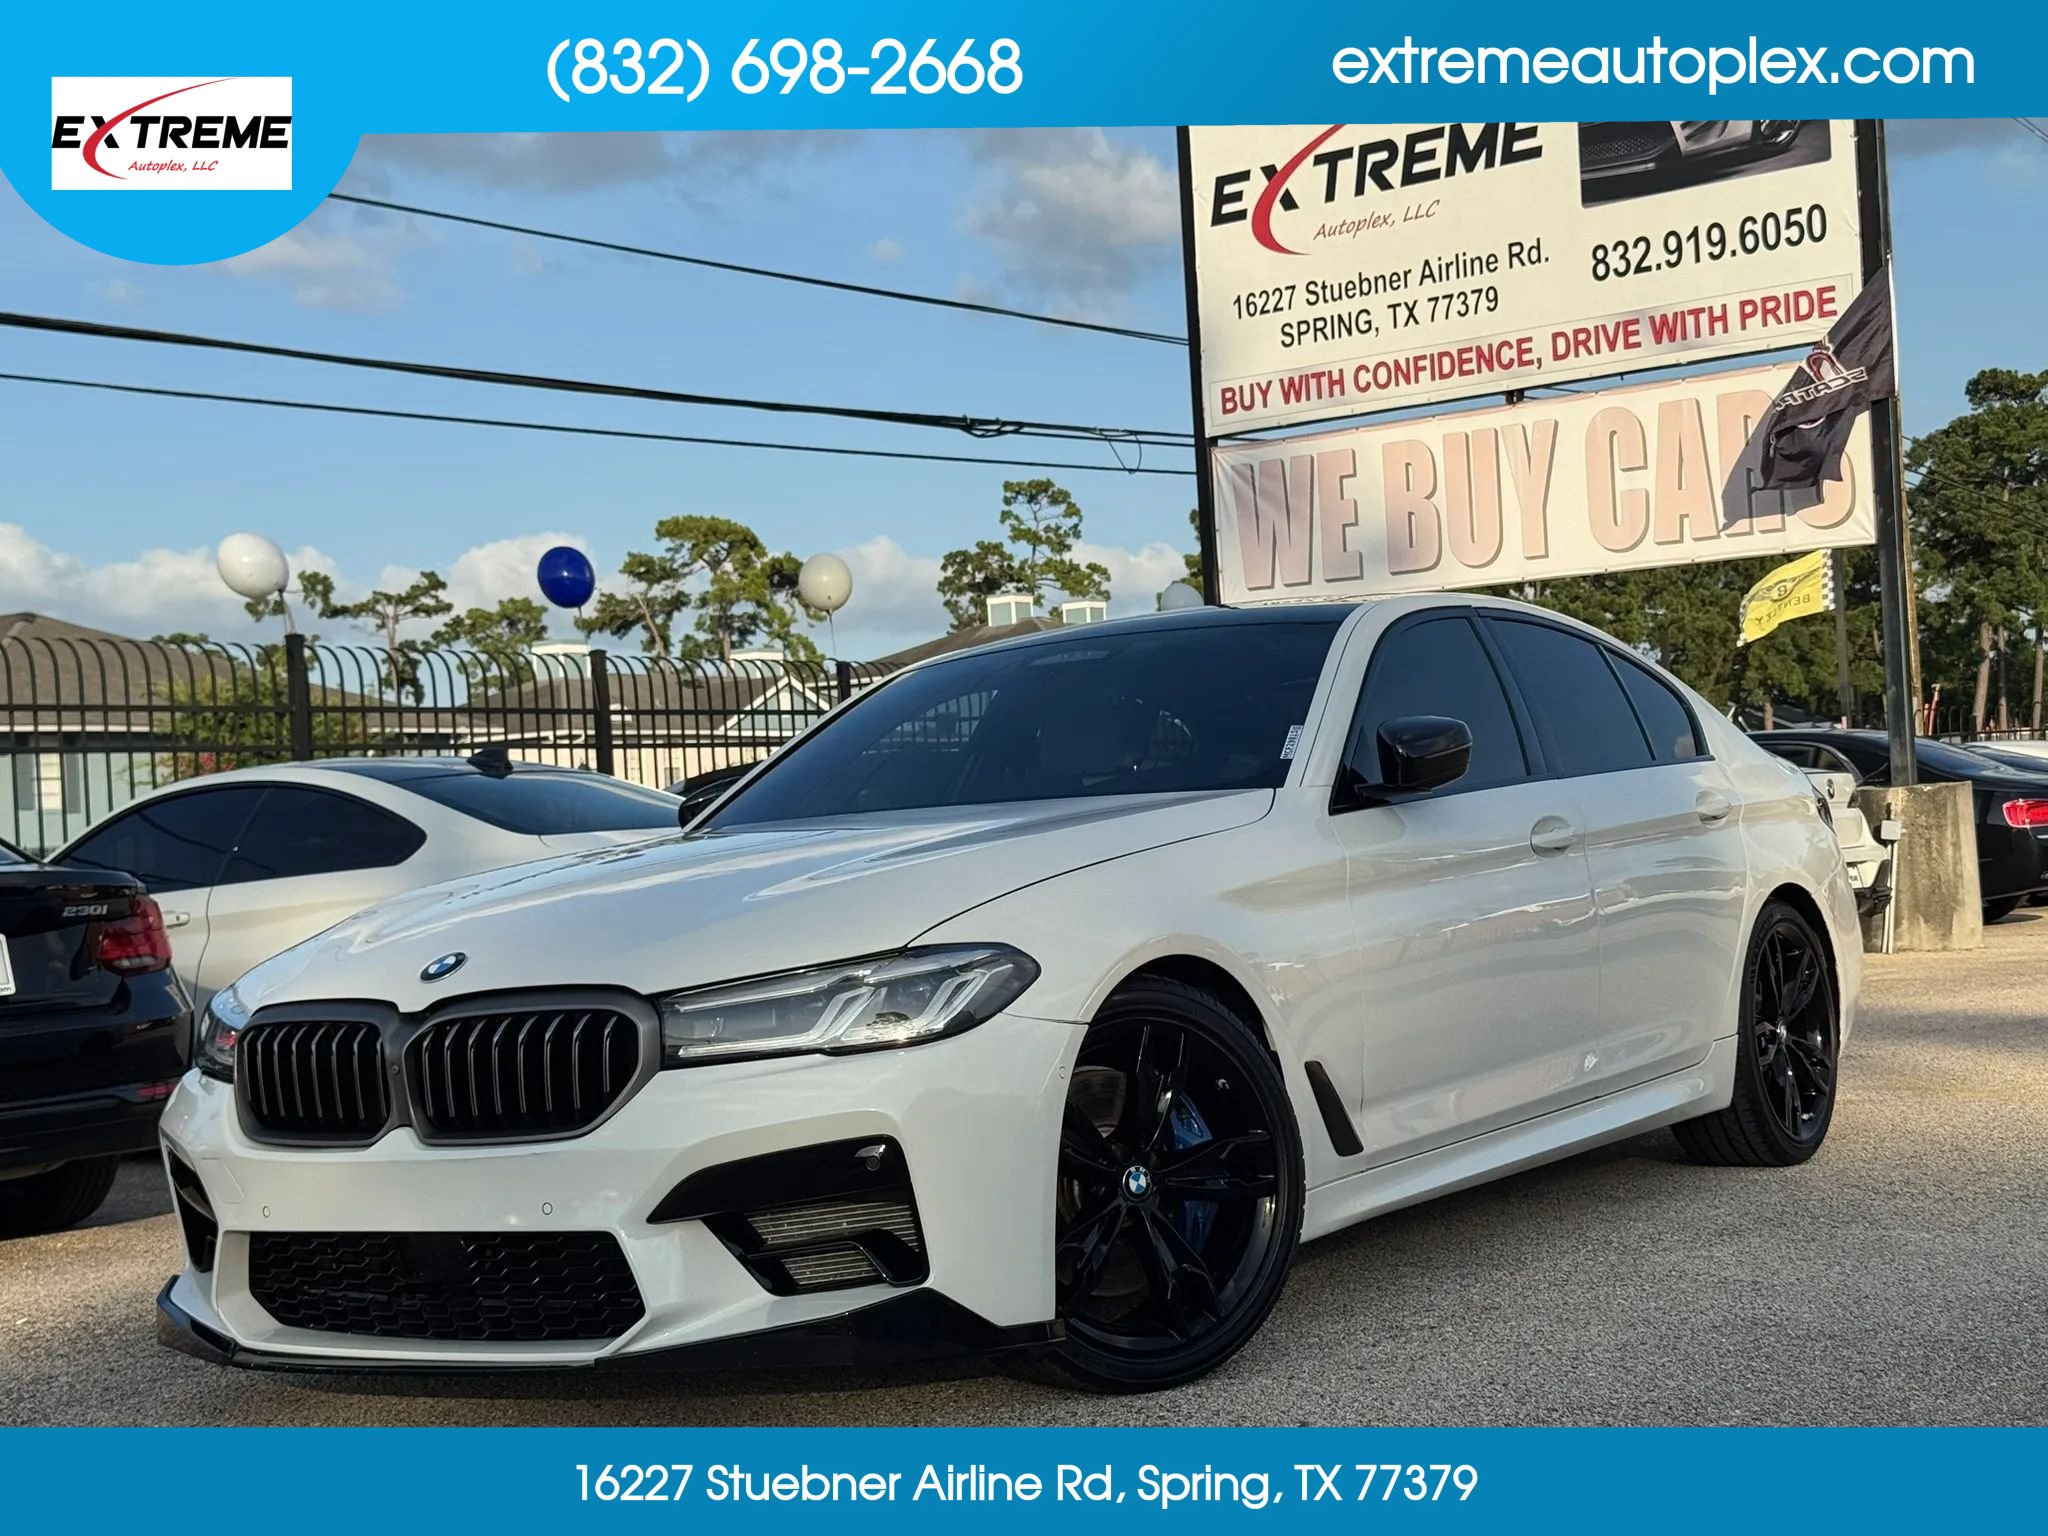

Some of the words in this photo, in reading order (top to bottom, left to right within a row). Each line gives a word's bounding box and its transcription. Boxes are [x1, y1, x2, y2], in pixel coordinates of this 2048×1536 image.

[1210, 122, 1543, 228] EXTREME
[1313, 211, 1396, 241] Autoplex,
[1402, 199, 1441, 223] LLC
[1591, 203, 1828, 282] 832.919.6050
[1232, 285, 1297, 320] 16227
[1305, 267, 1413, 308] Stuebner
[1419, 251, 1500, 286] Airline
[1507, 237, 1550, 269] Rd.
[1280, 308, 1380, 349] SPRING,
[1387, 299, 1421, 329] TX
[1427, 285, 1500, 322] 77379
[1220, 379, 1273, 415] BUY
[1279, 368, 1346, 405] WITH
[1352, 336, 1543, 394] CONFIDENCE,
[1551, 317, 1641, 361] DRIVE
[1650, 303, 1730, 346] WITH
[1738, 284, 1839, 331] PRIDE
[1230, 448, 1365, 592] WE
[1383, 418, 1559, 577] BUY
